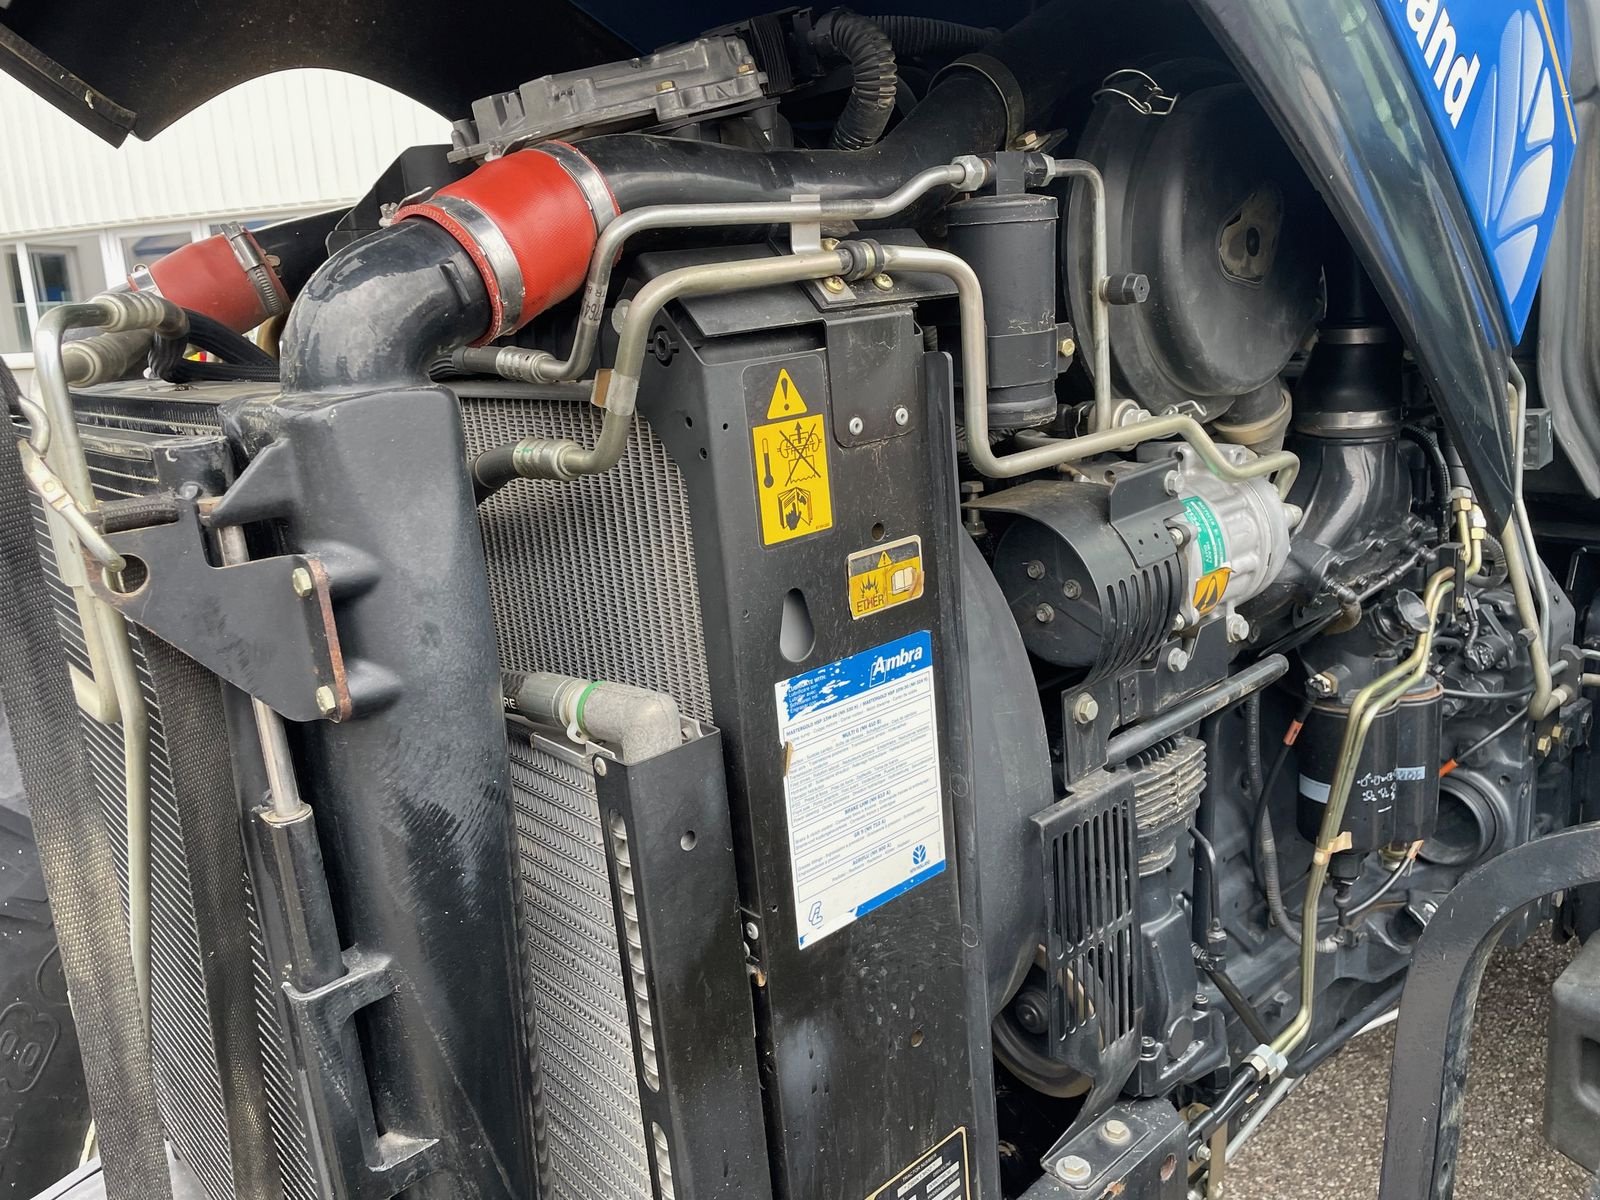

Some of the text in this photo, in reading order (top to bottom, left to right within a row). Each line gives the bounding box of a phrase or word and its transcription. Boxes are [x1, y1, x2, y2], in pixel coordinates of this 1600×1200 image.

[1407, 0, 1480, 130] and
[856, 593, 885, 612] ETHER
[872, 645, 923, 676] Ambra
